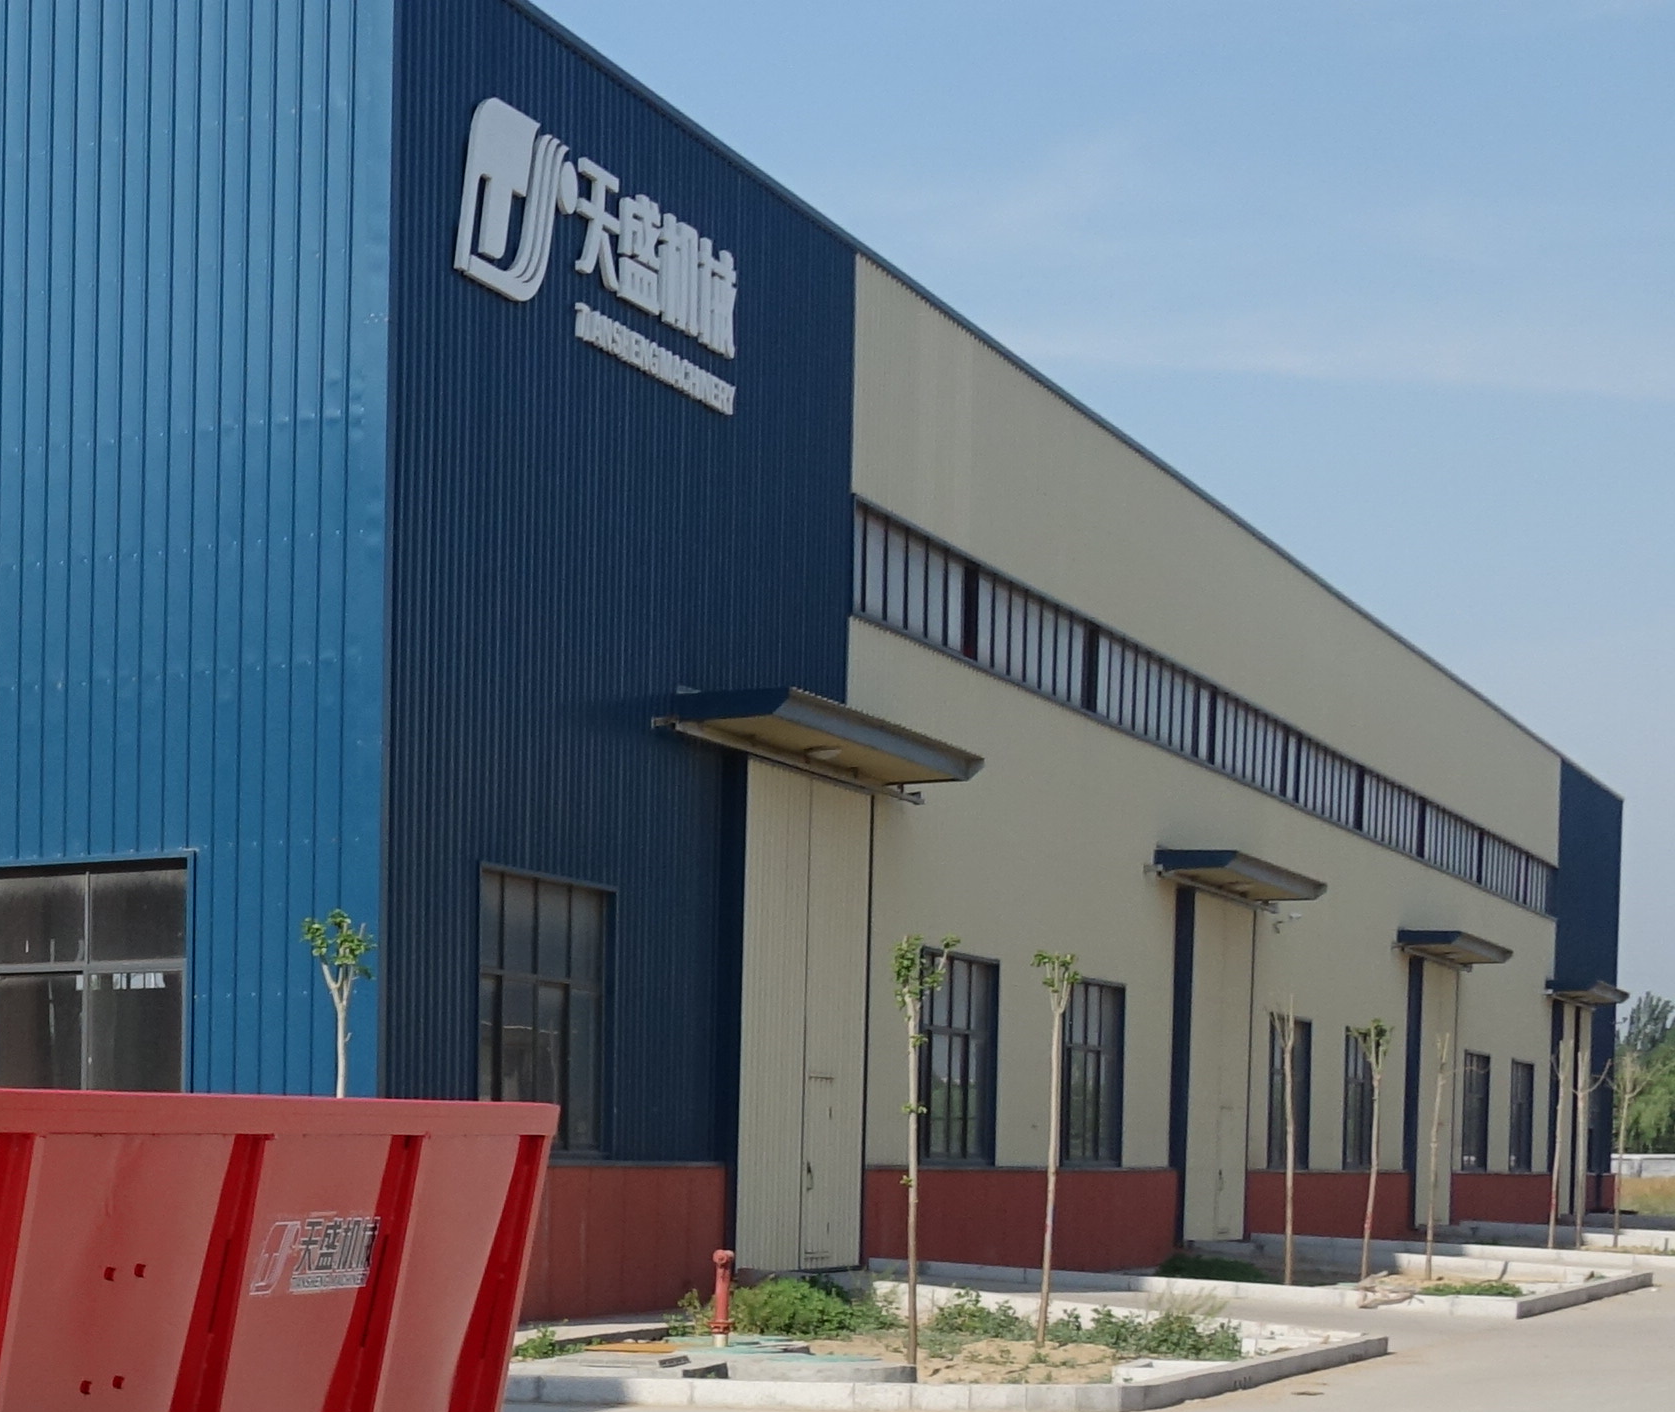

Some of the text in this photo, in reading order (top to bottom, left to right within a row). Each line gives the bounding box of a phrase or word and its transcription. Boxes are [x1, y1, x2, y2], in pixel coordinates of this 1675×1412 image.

[574, 157, 738, 359] 天盛机械
[574, 302, 737, 415] TIANSHENG MACHINERY
[293, 1217, 380, 1273] 天盛机械
